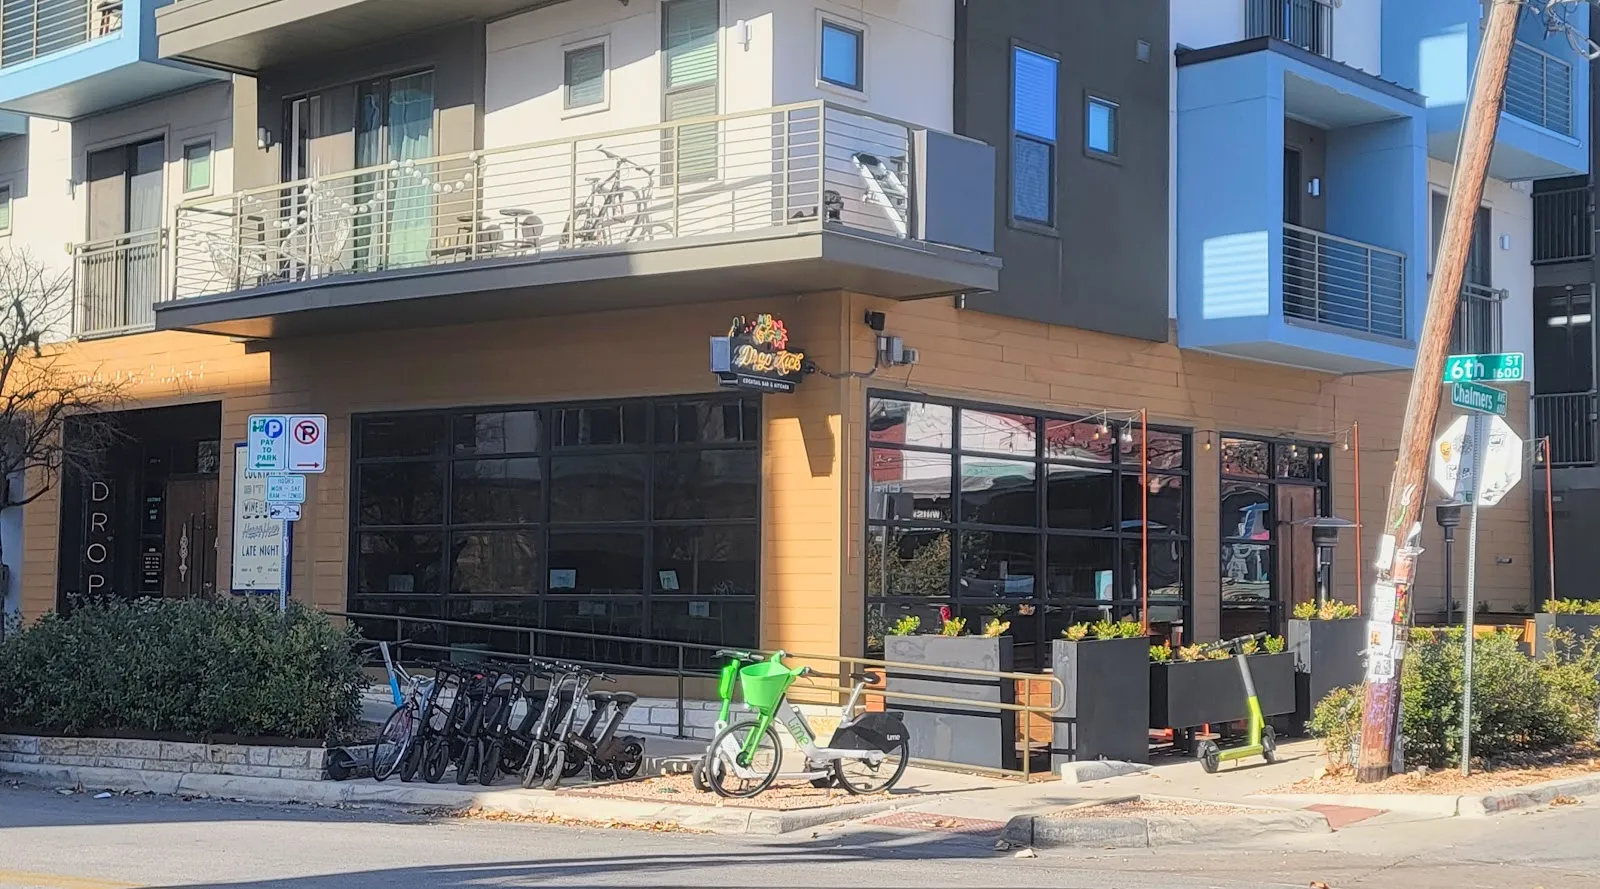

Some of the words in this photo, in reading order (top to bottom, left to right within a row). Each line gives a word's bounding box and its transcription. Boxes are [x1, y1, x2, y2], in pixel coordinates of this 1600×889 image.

[1505, 355, 1520, 366] ST
[1451, 358, 1485, 379] 6th
[1493, 367, 1520, 379] 1600
[762, 380, 770, 388] BAR
[1454, 382, 1493, 410] Chalmers
[1497, 392, 1506, 403] AVE
[243, 500, 259, 513] WINE
[87, 481, 109, 594] DROP
[241, 545, 256, 557] LATE
[259, 545, 280, 557] NIGHT
[786, 716, 809, 746] Lime
